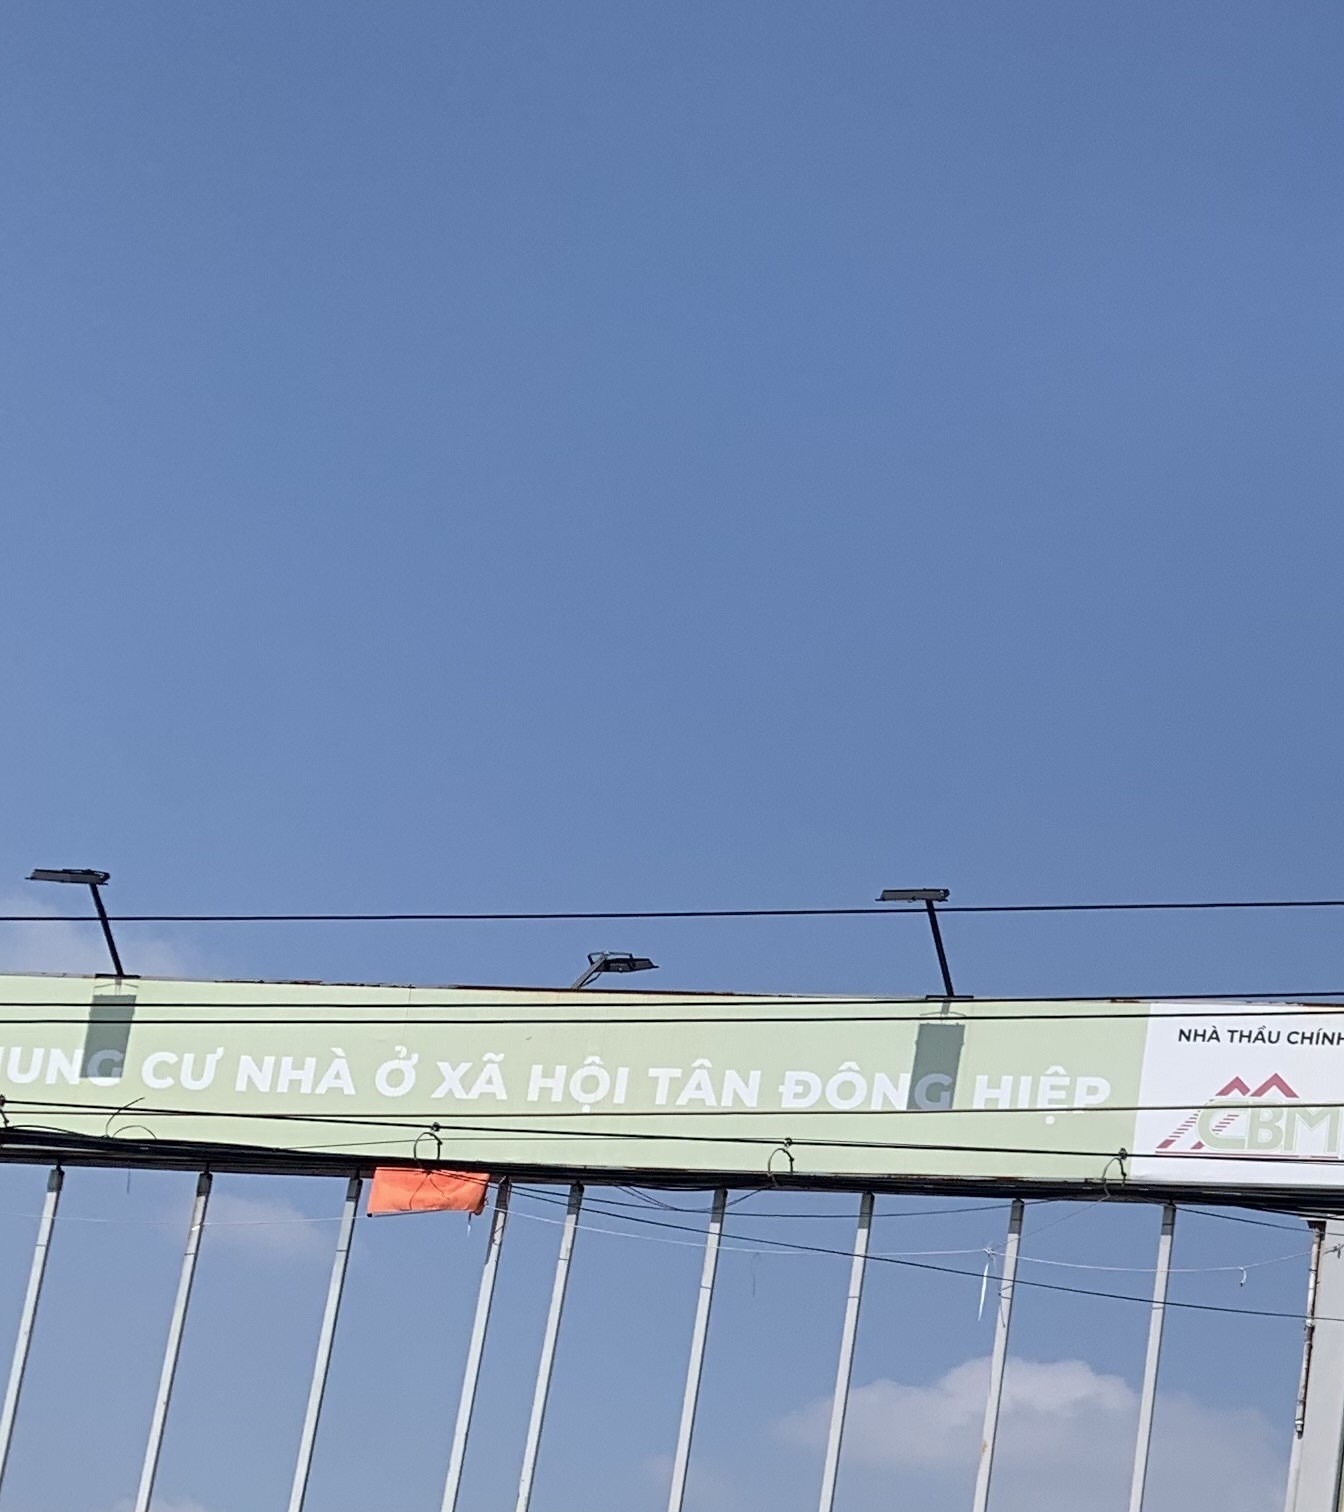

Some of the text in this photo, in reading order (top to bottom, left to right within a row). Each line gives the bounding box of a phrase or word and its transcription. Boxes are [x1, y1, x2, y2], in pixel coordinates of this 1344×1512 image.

[1177, 1024, 1221, 1043] NHÀ
[1226, 1024, 1281, 1045] THẦU
[0, 1045, 1112, 1126] UNG CƯ NHÀ Ở XÃ HỘI TÂN ĐÔNG HIỆP
[1197, 1098, 1342, 1154] CBM
